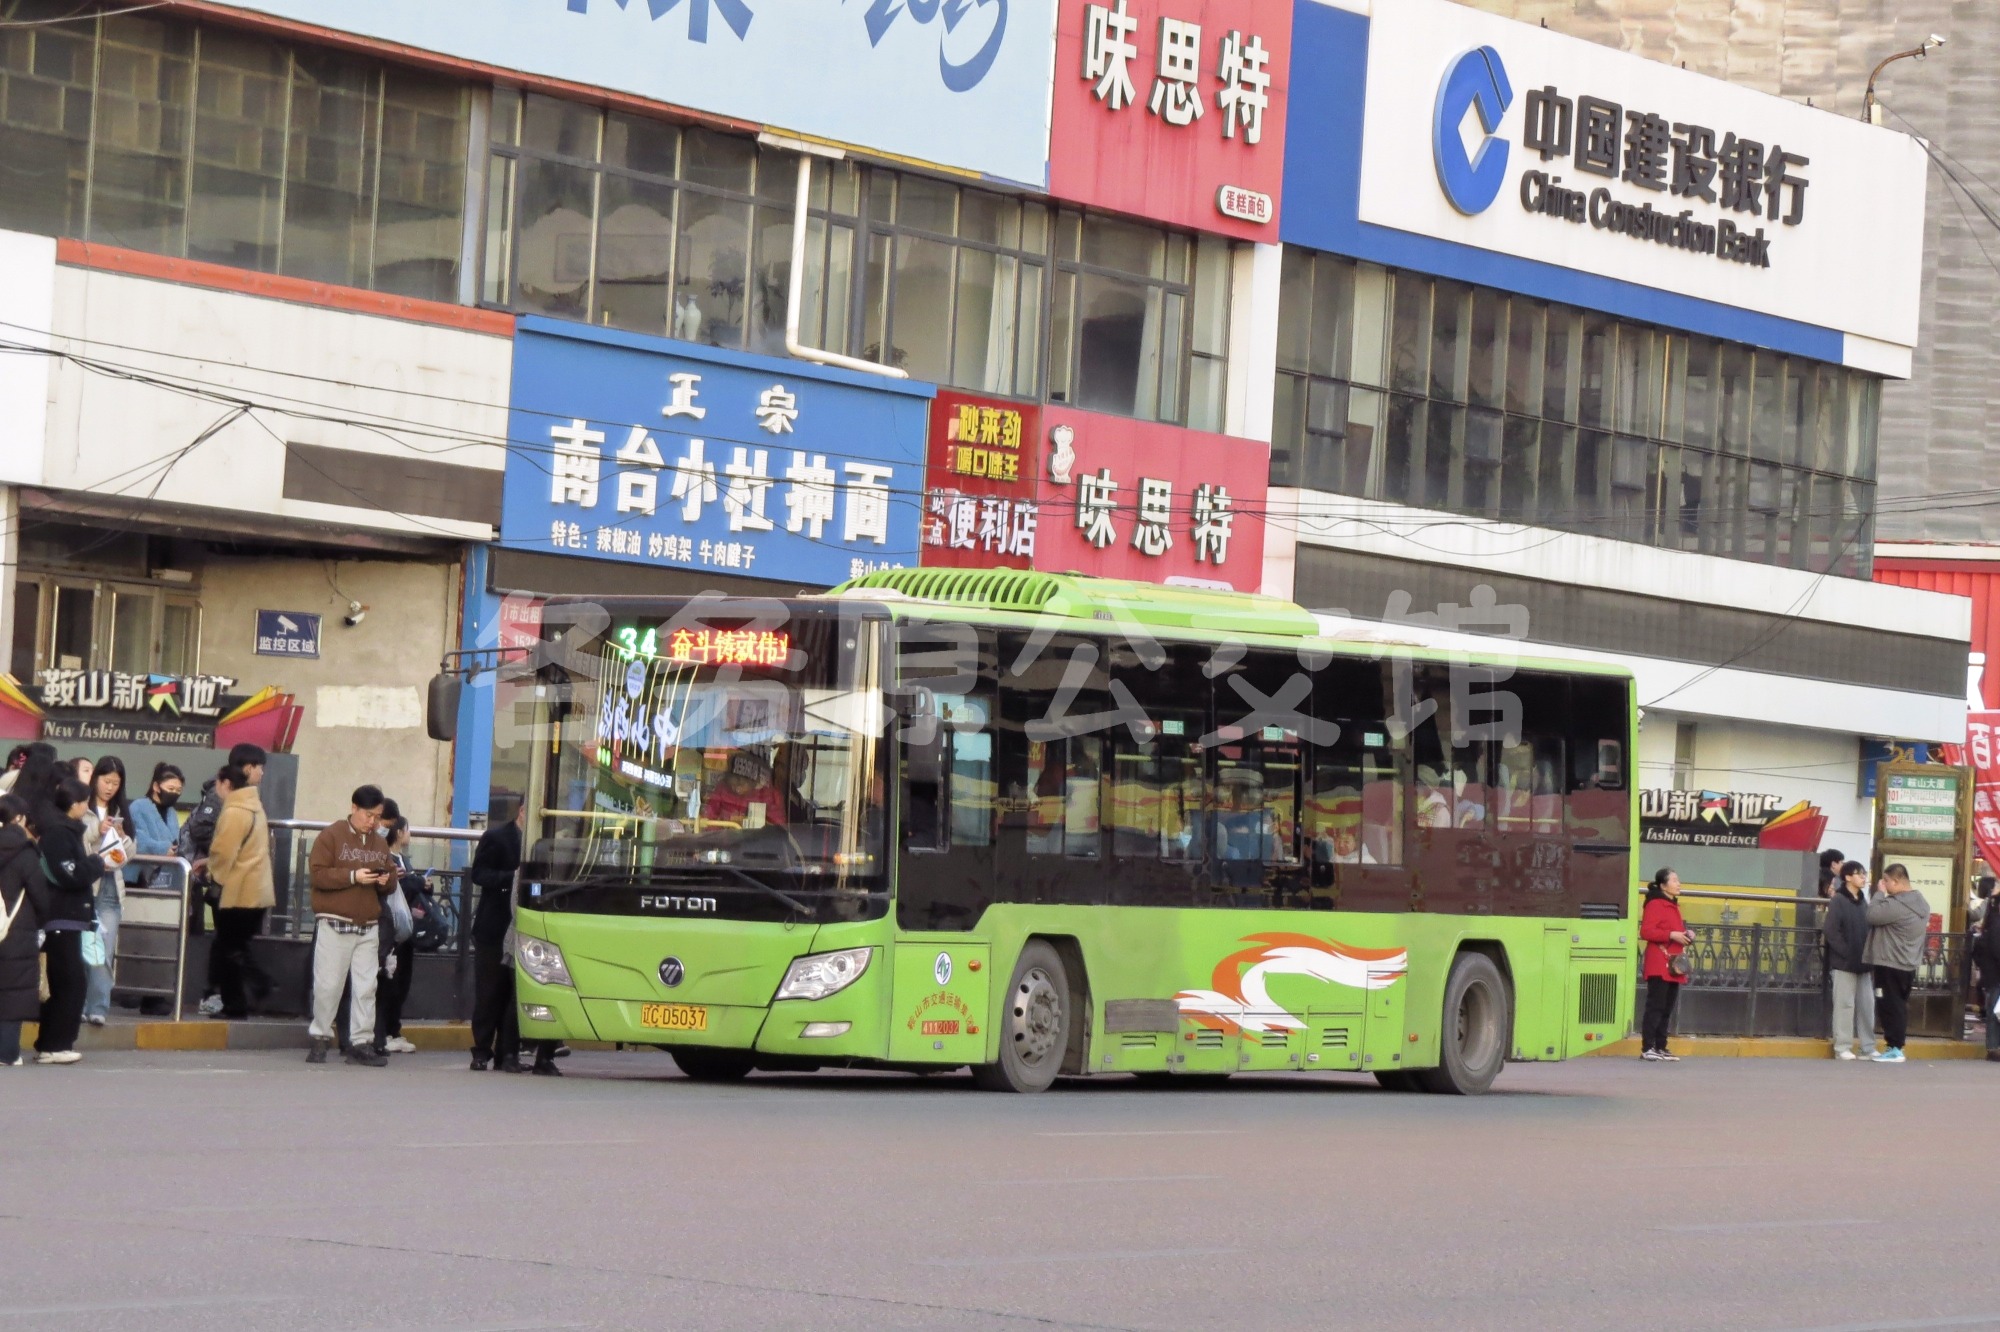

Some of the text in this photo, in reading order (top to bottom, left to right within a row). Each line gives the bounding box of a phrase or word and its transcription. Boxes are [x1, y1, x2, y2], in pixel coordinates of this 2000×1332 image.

[1082, 0, 1271, 144] 味思特
[1523, 86, 1810, 226] 中国建设银行
[1225, 190, 1266, 218] 蛋糕面包
[1520, 169, 1771, 268] China Construction Bank
[661, 372, 799, 434] 正宗
[550, 418, 894, 545] 南台小杜抻面
[597, 525, 642, 556] 辣椒油
[648, 532, 693, 563] 炒鸡架
[949, 492, 1039, 558] 便利店
[1076, 468, 1234, 565] 味思特
[259, 636, 316, 653] 监控区域
[617, 626, 657, 661] 34
[1639, 788, 1782, 827] 山新天地
[641, 895, 717, 911] FOTON
